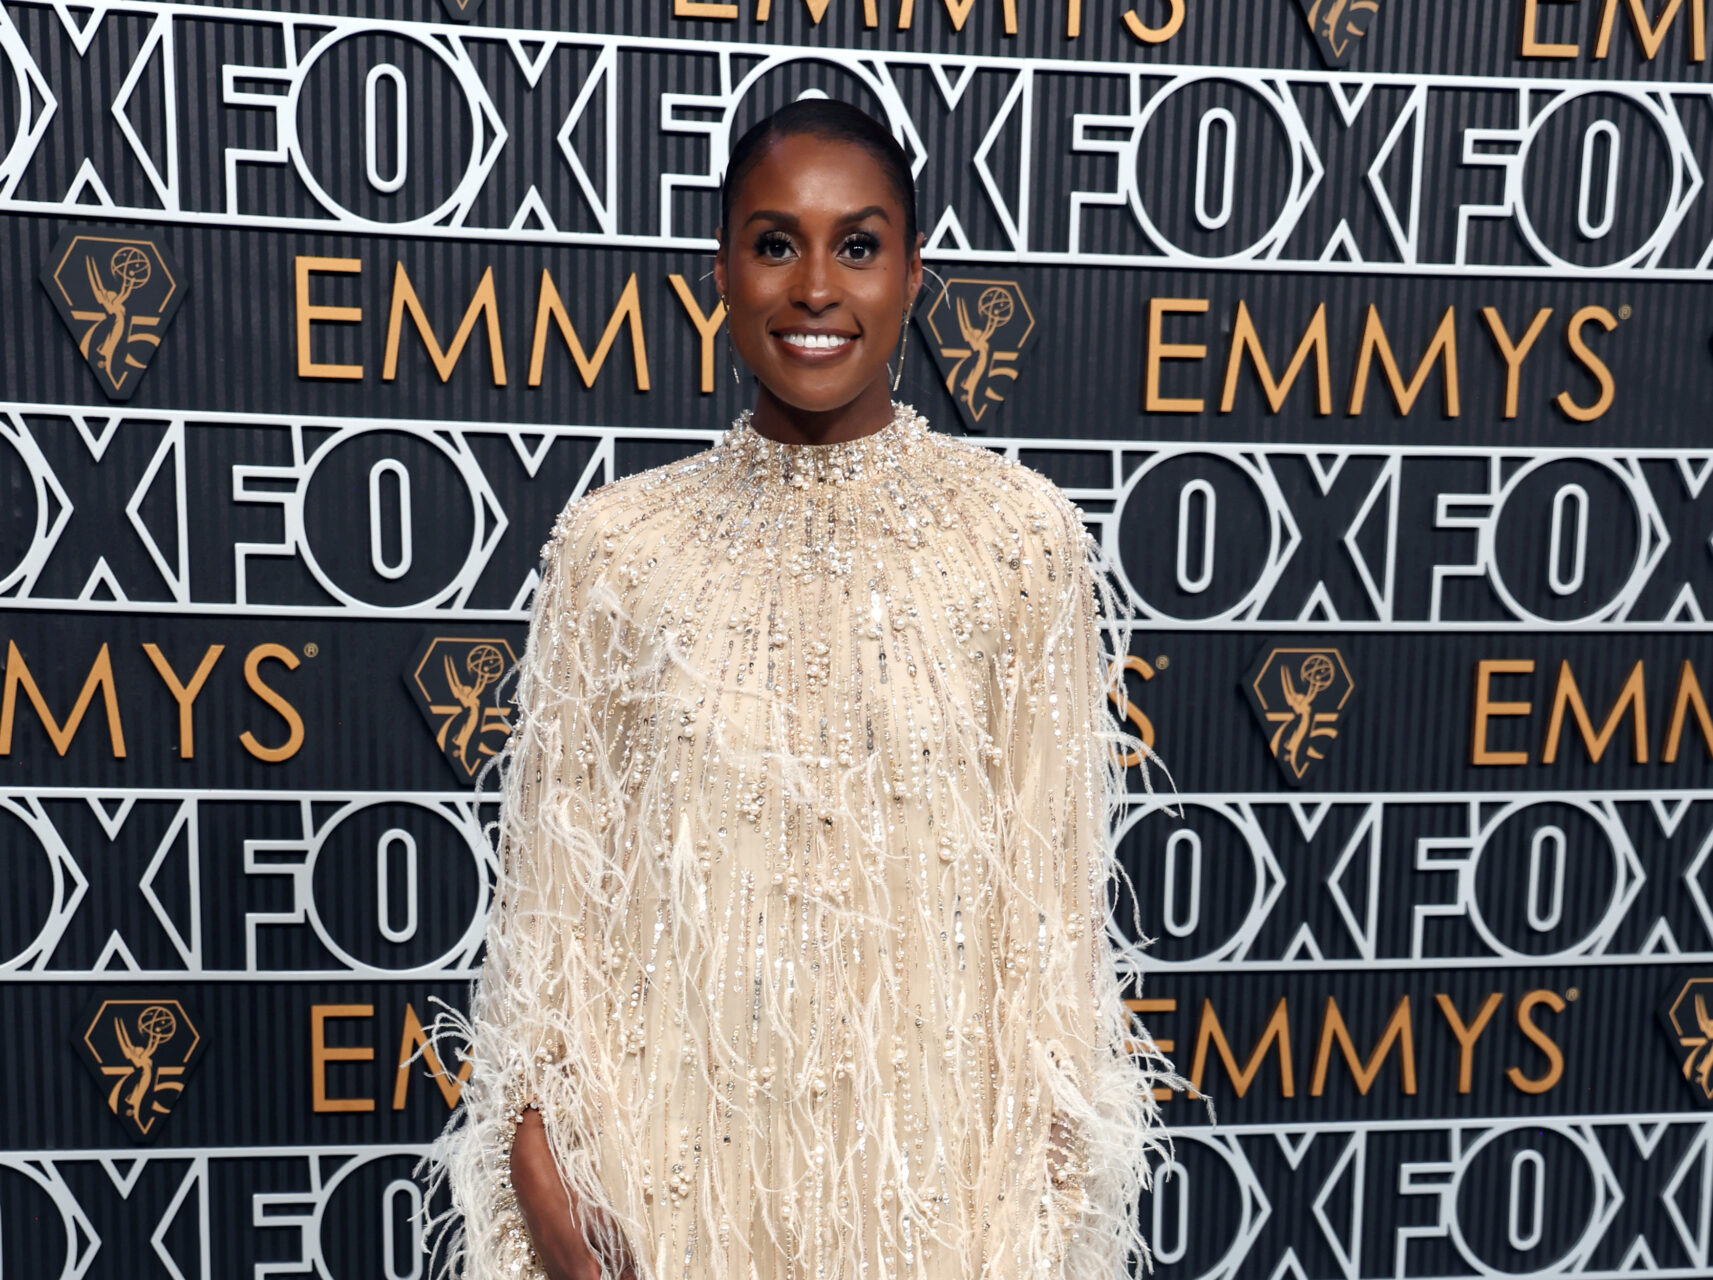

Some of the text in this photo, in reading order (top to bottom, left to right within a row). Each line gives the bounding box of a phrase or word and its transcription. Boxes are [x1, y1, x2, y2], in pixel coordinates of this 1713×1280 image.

[162, 5, 617, 244] FOX
[1018, 58, 1427, 275] FOX
[170, 406, 615, 621] FOX
[184, 788, 501, 981] FO
[1364, 789, 1713, 970] FOX
